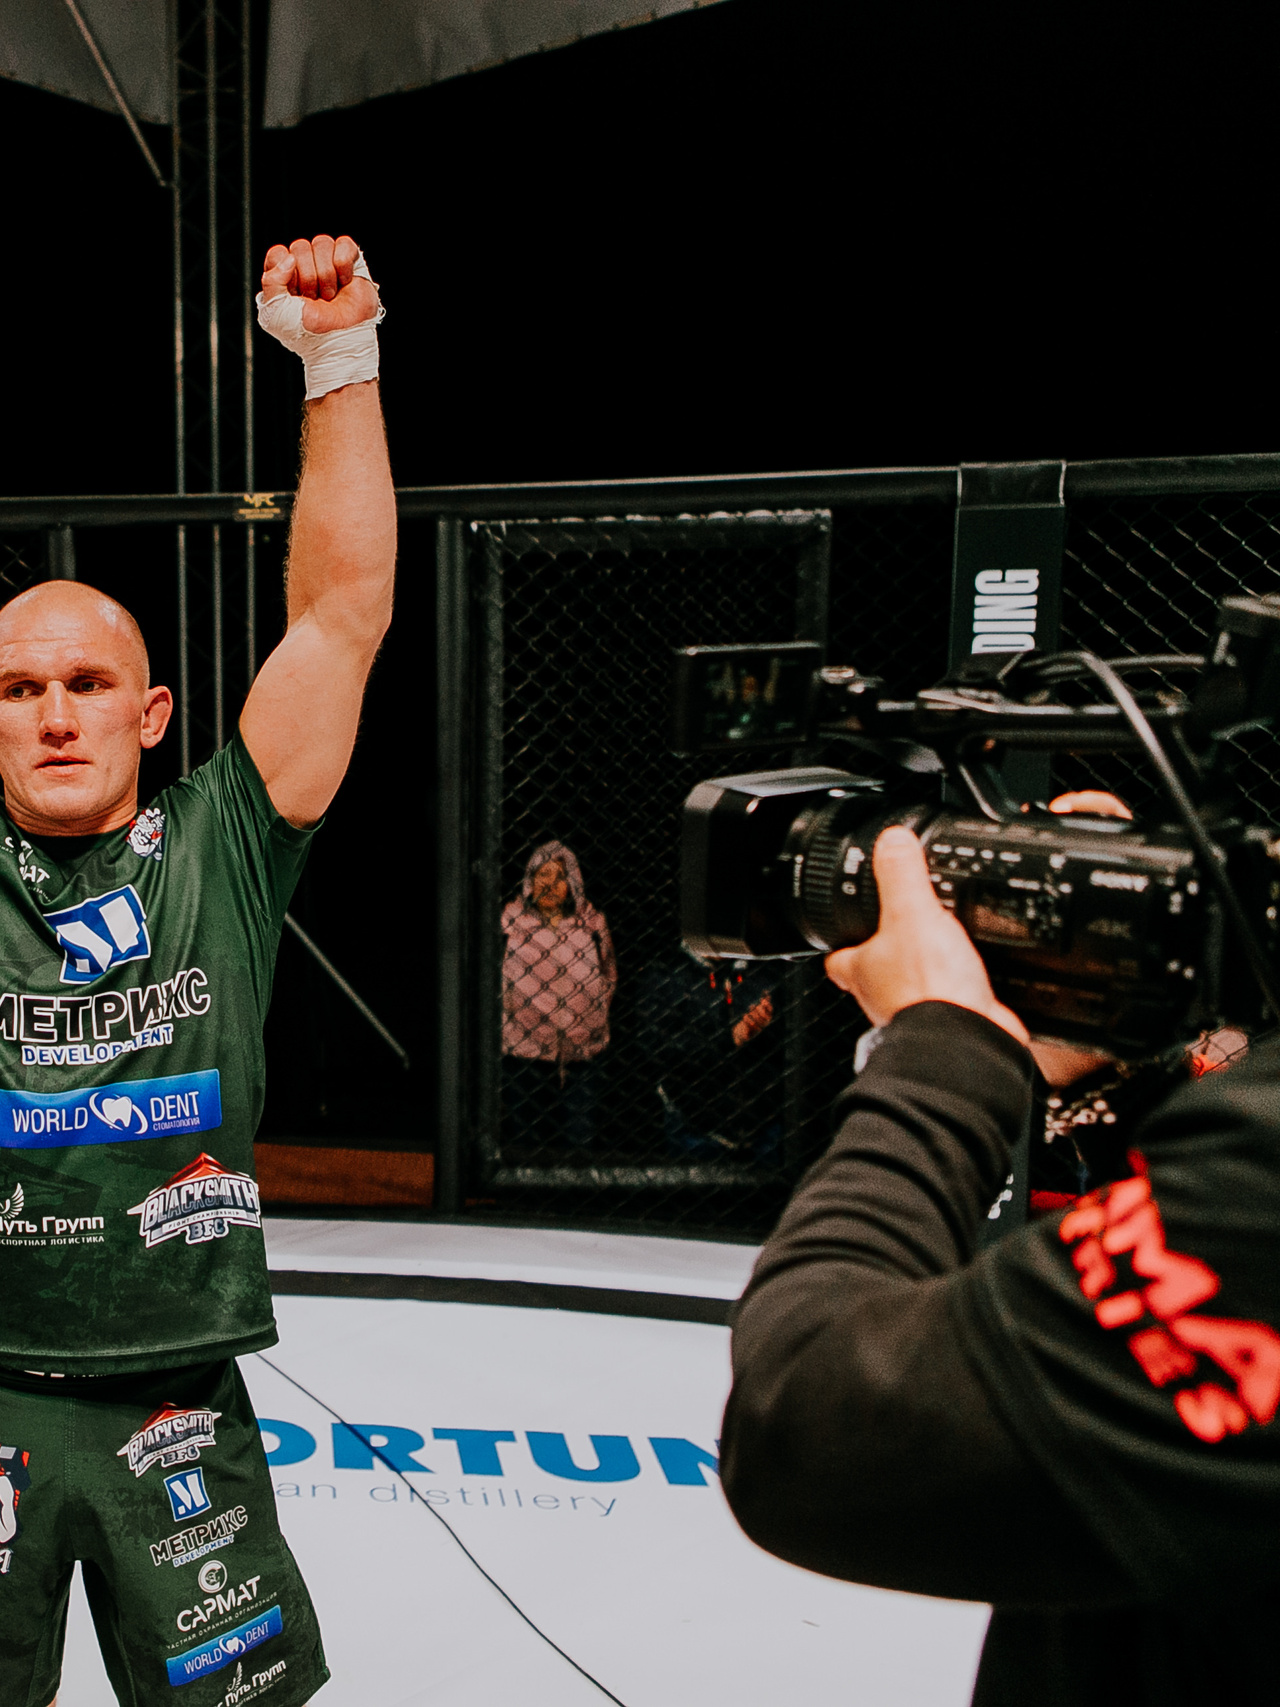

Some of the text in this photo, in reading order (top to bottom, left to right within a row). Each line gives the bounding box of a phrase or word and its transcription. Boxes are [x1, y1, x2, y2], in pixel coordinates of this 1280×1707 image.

[11, 1091, 200, 1134] WORLD DENT
[41, 1215, 105, 1235] Групп
[144, 1177, 259, 1231] BLACKSMITH
[50, 1235, 105, 1246] ЛОГИСТИКА
[190, 1218, 225, 1239] BFC
[130, 1413, 213, 1466] BLACKSMITH
[164, 1445, 199, 1464] BFC
[369, 1483, 617, 1517] distillery
[150, 1505, 248, 1567] МЕТРИКС
[172, 1534, 235, 1568] DEVELOPMENT
[176, 1575, 261, 1632] САРМАТ
[183, 1647, 223, 1675] WORLD
[245, 1620, 270, 1645] DENT
[224, 1684, 251, 1707] Путь
[251, 1660, 287, 1688] Групп
